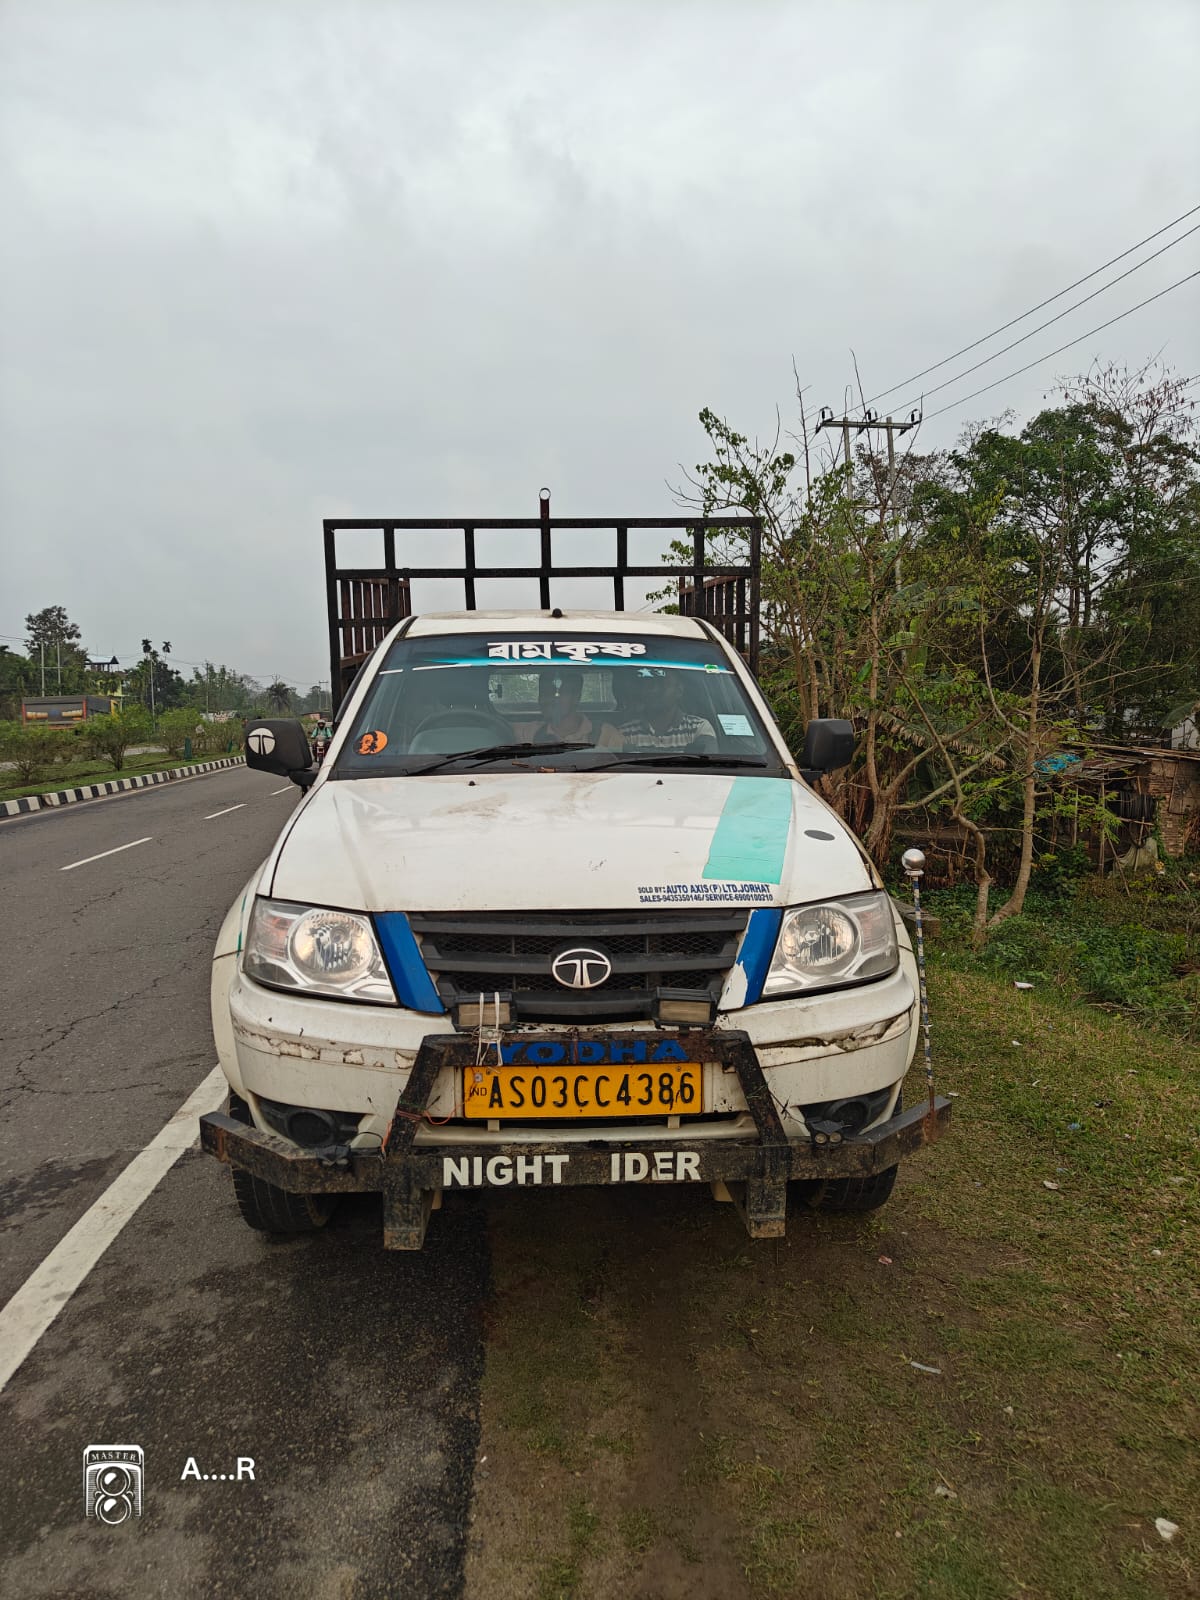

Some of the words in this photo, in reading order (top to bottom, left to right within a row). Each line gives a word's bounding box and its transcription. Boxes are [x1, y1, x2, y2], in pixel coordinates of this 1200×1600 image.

[490, 1039, 690, 1064] YODHA
[489, 1072, 695, 1108] AS03CC4386
[443, 1154, 570, 1186] NIGHT
